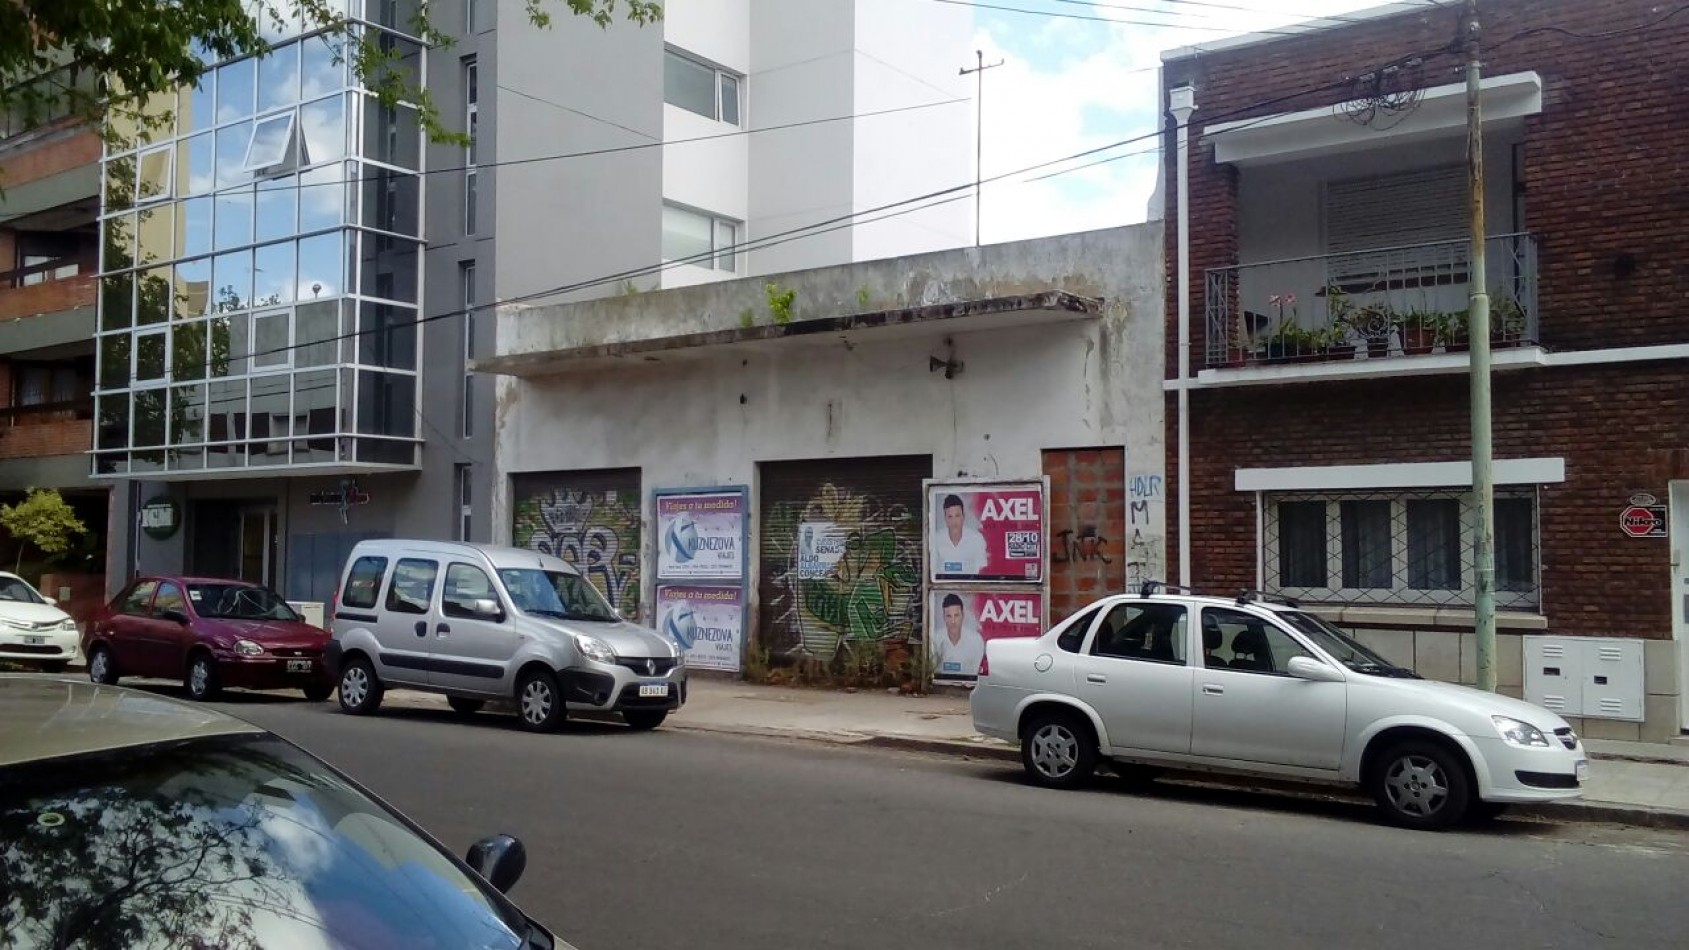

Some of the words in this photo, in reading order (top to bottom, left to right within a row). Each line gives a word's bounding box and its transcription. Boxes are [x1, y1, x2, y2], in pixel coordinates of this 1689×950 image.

[665, 501, 687, 511] Viajes
[695, 501, 702, 509] tu
[703, 500, 737, 509] medida!
[981, 498, 1039, 521] AXEL
[688, 537, 735, 551] KUZNEZOVA
[664, 589, 687, 600] Viajes
[694, 591, 702, 599] tu
[703, 591, 737, 600] medida!
[980, 600, 1039, 623] AXEL
[687, 627, 733, 642] KUZNEZOVA
